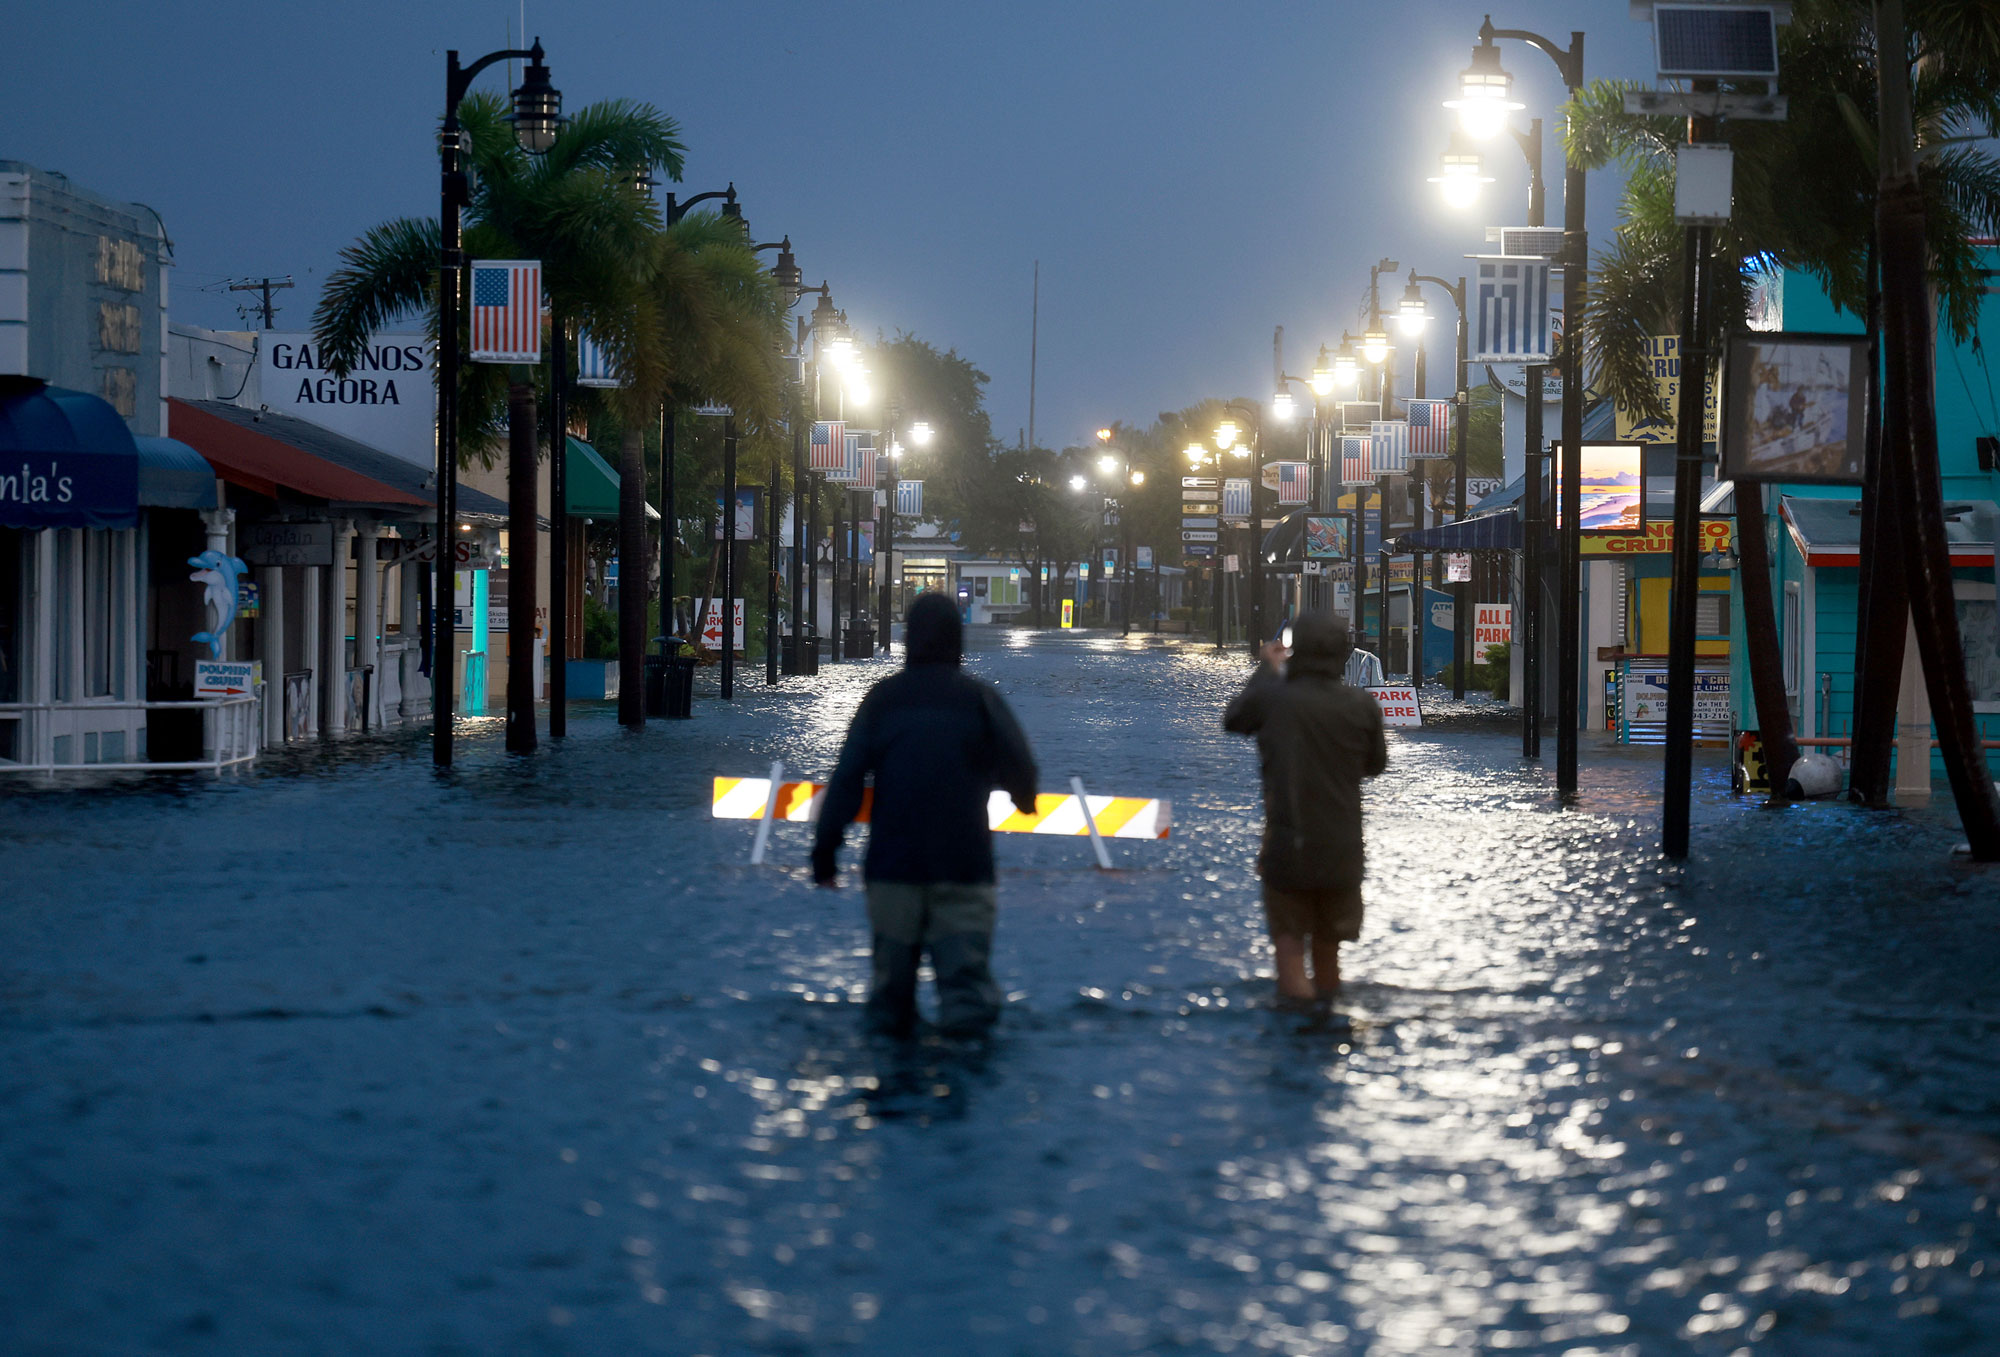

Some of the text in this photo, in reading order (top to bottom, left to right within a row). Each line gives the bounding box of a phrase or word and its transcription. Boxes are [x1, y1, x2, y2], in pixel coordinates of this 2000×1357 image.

[272, 343, 424, 371] GALNOS
[295, 378, 401, 405] AGORA
[1479, 609, 1501, 625] ALL
[198, 664, 251, 676] DOLPHIN
[205, 676, 244, 686] CRUISE
[1368, 691, 1413, 701] PARK
